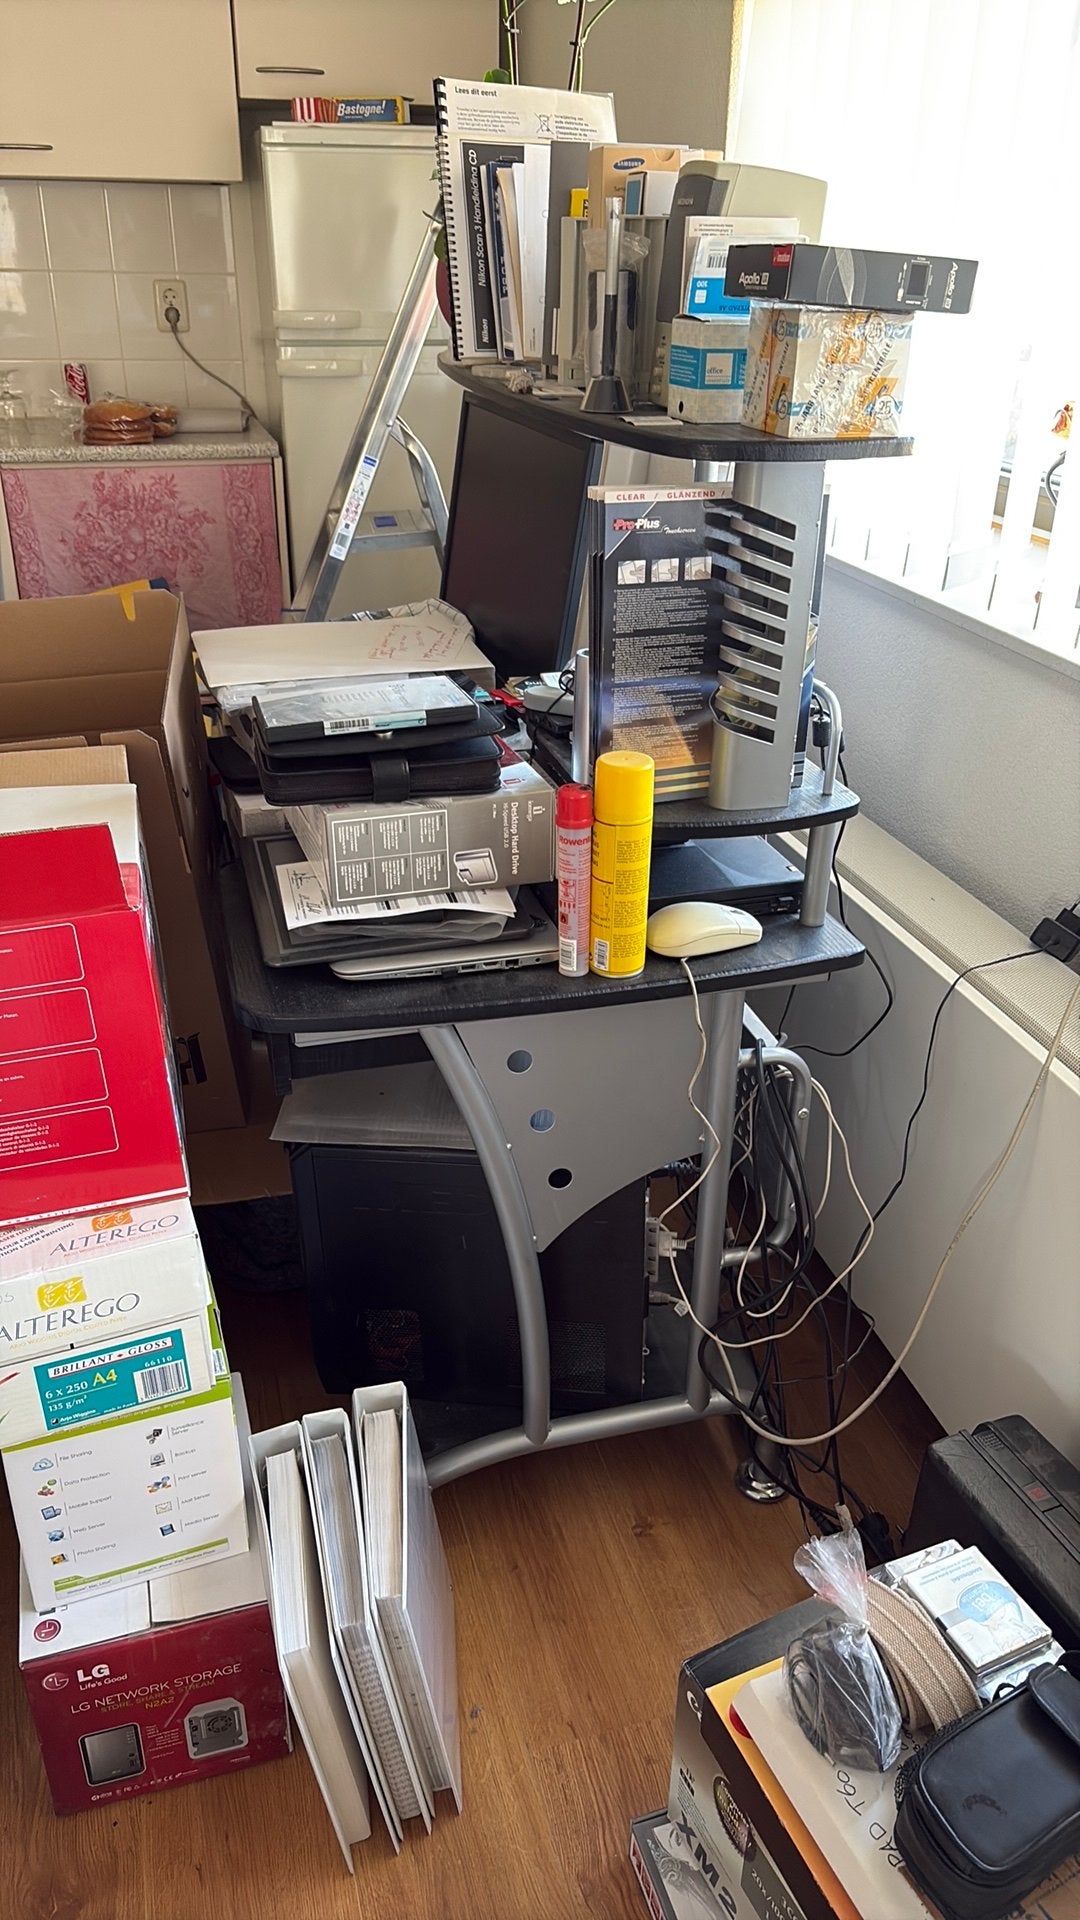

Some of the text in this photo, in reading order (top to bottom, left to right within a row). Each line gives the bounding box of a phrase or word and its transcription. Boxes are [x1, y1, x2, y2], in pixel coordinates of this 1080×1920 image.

[454, 86, 470, 94] Lees
[337, 100, 386, 117] Bastogne!
[469, 150, 478, 164] CD
[474, 224, 483, 232] 3
[475, 233, 485, 256] Scan
[478, 256, 487, 287] Nikon
[739, 272, 760, 286] Apollo
[947, 262, 958, 296] Apollo
[510, 802, 518, 834] Desktop
[511, 835, 519, 854] Hard
[41, 1222, 75, 1241] PRINTING
[50, 1215, 180, 1256] ALTEREGO
[0, 1293, 140, 1343] ALTEREGO
[53, 1339, 168, 1376] BRILLANT GLOSS
[144, 1356, 173, 1368] 66110
[45, 1391, 53, 1400] 6
[66, 1382, 88, 1394] 250
[92, 1369, 118, 1387] A4
[49, 1402, 63, 1412] 135
[60, 1414, 72, 1423] Arjo
[70, 1449, 93, 1460] Sharing
[64, 1471, 110, 1487] Data Protection
[90, 1495, 112, 1506] Support
[73, 1522, 105, 1535] Web Server
[77, 1664, 110, 1682] LG
[71, 1664, 242, 1714] LG NETWORK STORAGE
[80, 1674, 128, 1691] Life's Good
[145, 1697, 175, 1710] N2A2
